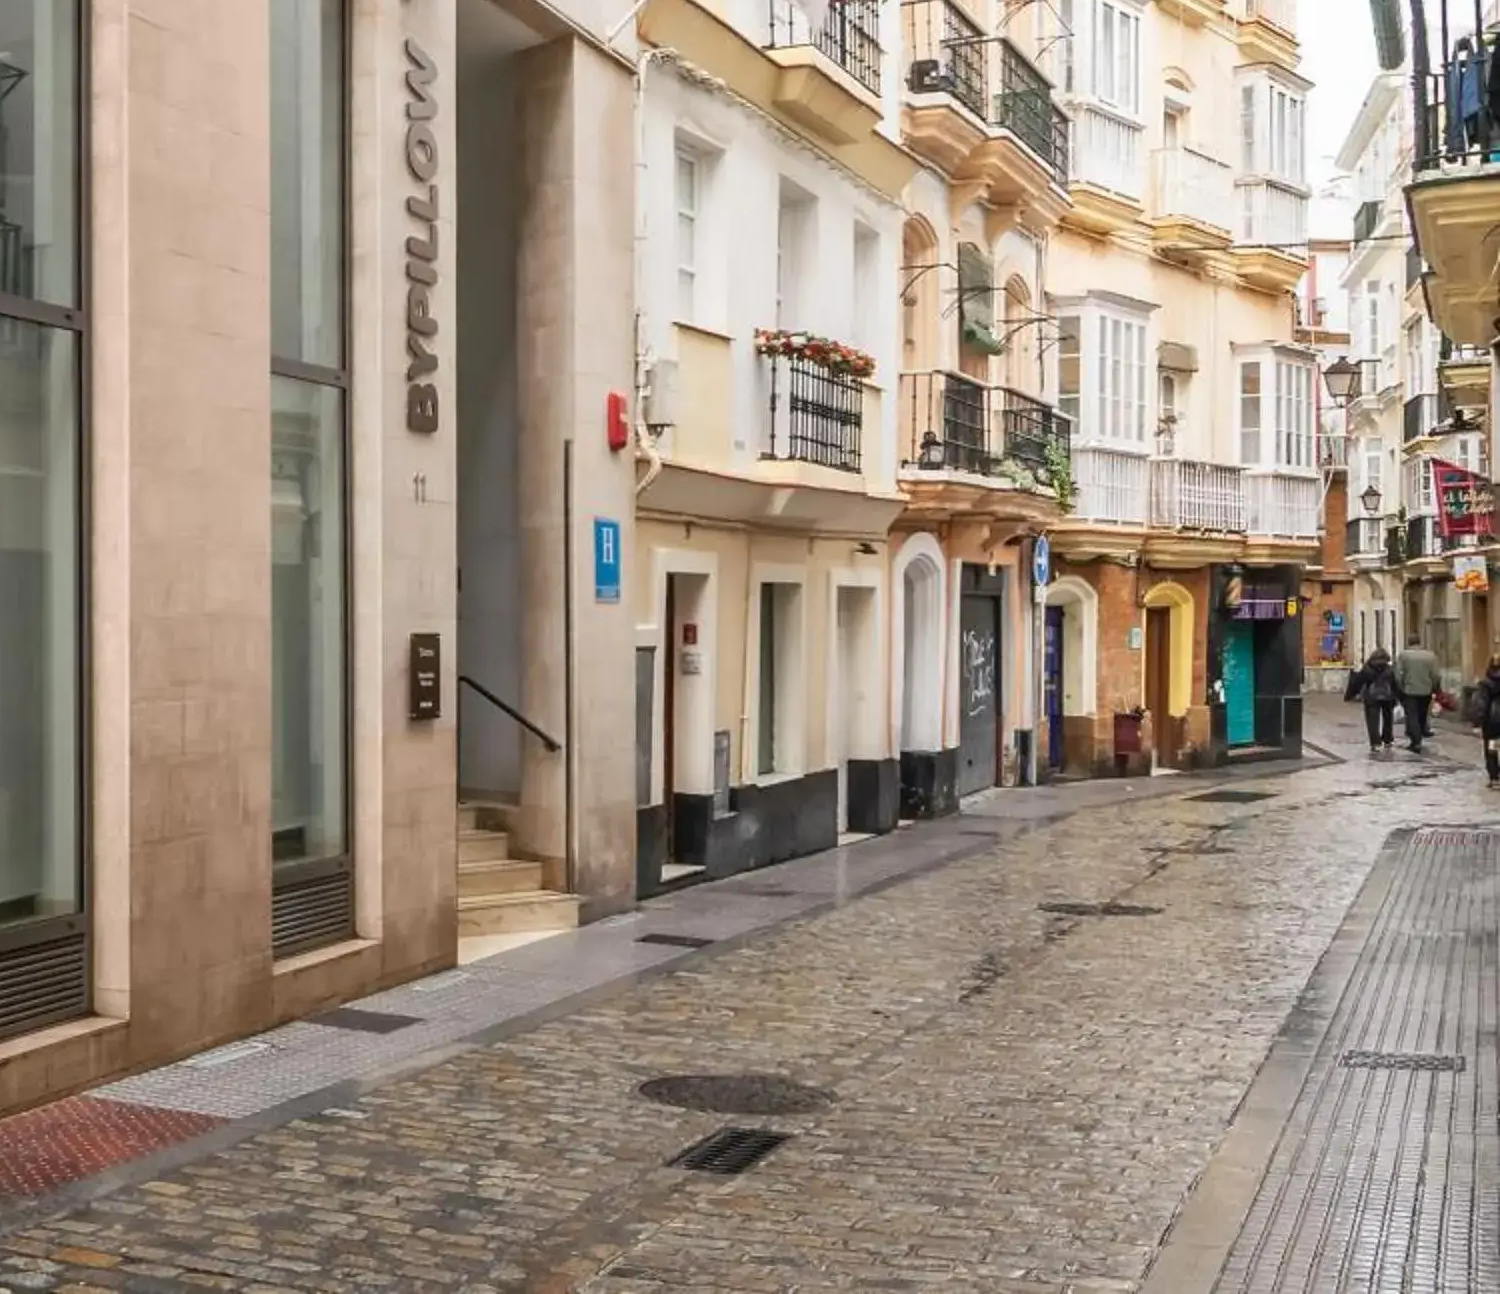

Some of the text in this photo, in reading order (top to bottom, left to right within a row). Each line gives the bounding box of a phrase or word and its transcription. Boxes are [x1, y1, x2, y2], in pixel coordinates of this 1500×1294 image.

[405, 37, 439, 434] BYPILLOW
[413, 472, 426, 505] 11
[601, 526, 615, 564] H
